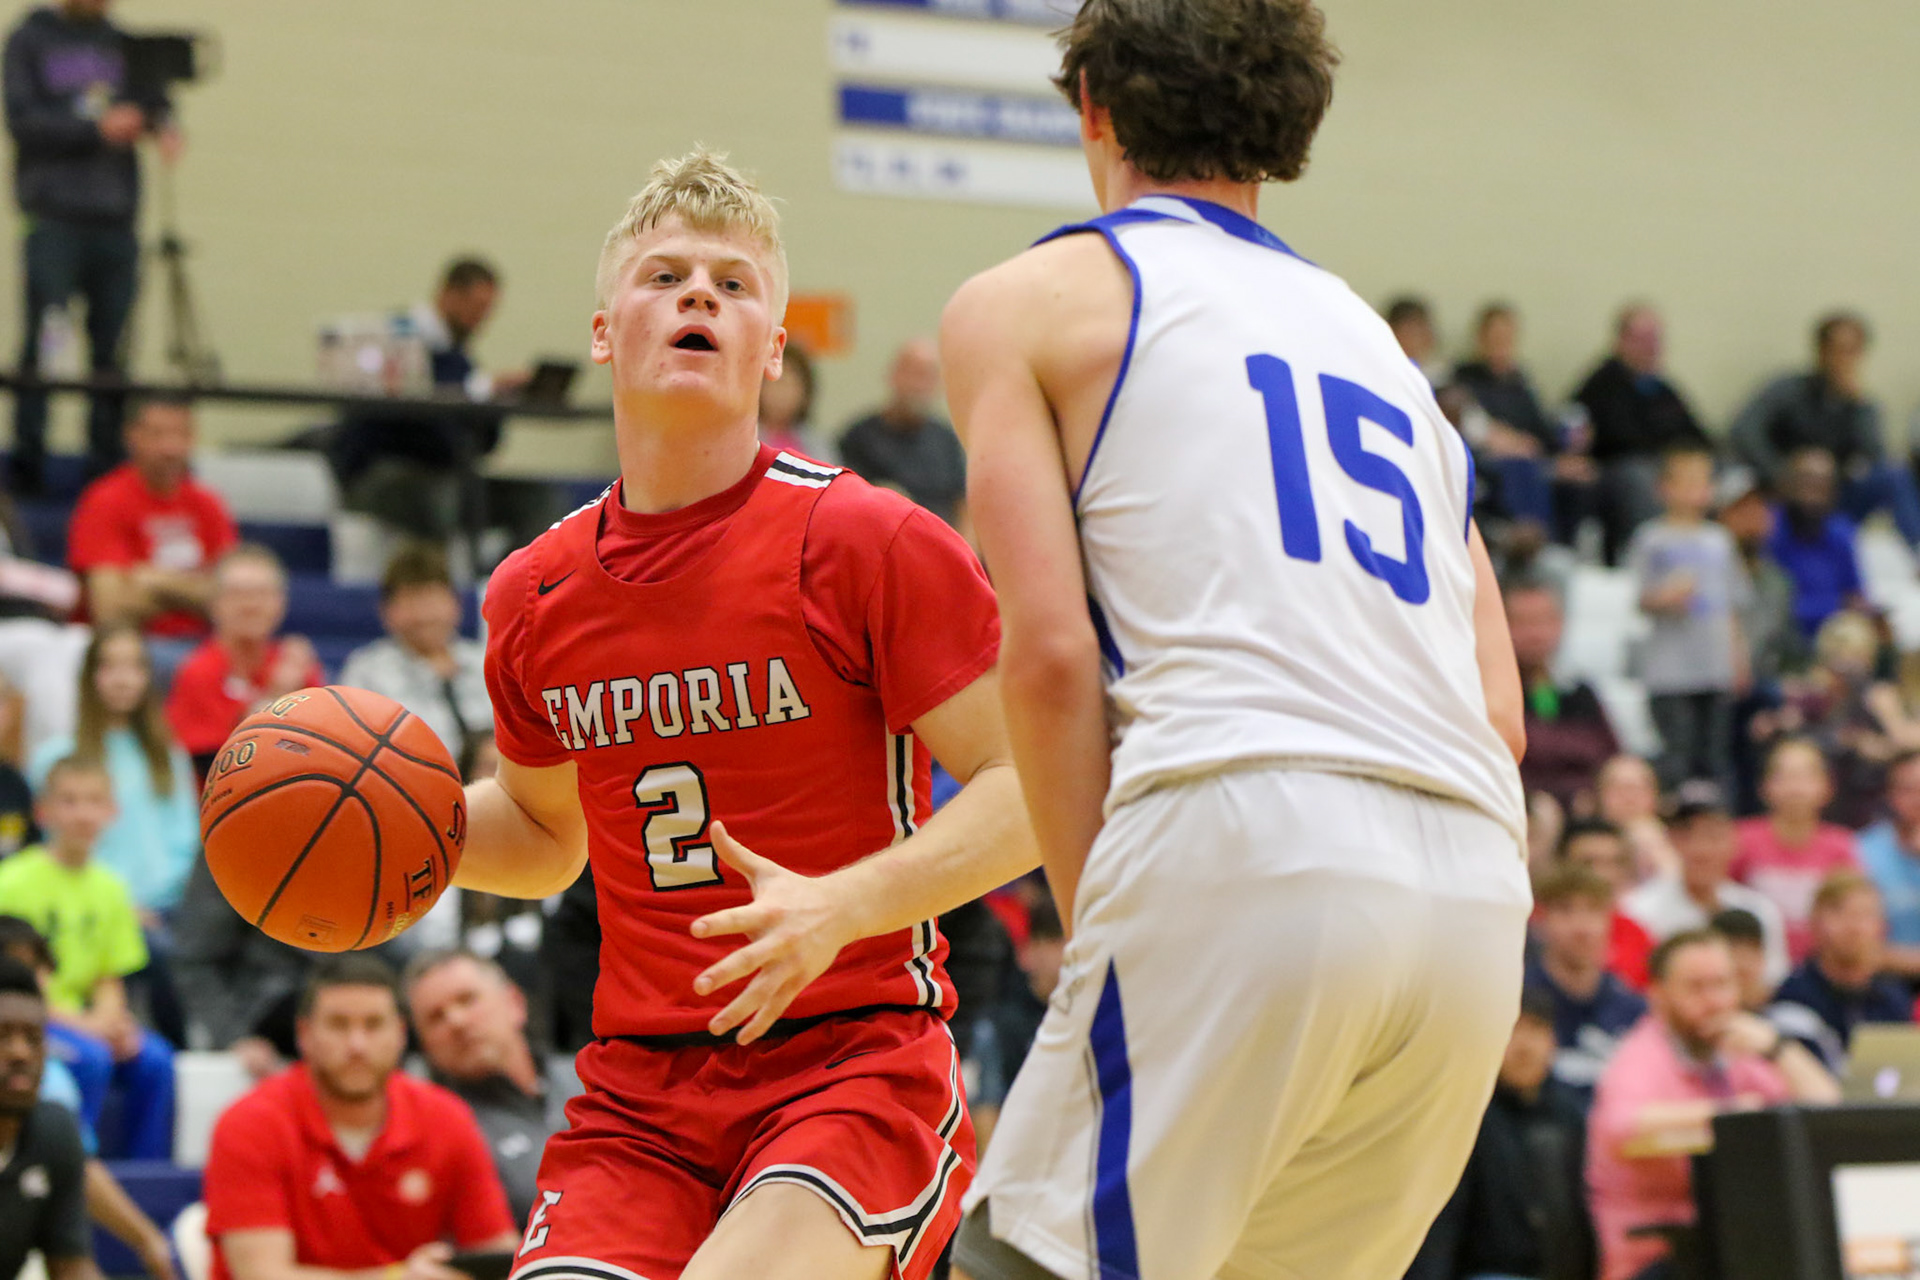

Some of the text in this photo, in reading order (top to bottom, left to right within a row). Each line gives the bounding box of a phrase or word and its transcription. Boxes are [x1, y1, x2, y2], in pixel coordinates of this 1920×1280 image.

[1245, 354, 1430, 605] 15
[541, 657, 811, 750] EMPORIA
[632, 761, 724, 892] 2
[518, 1190, 564, 1259] E
